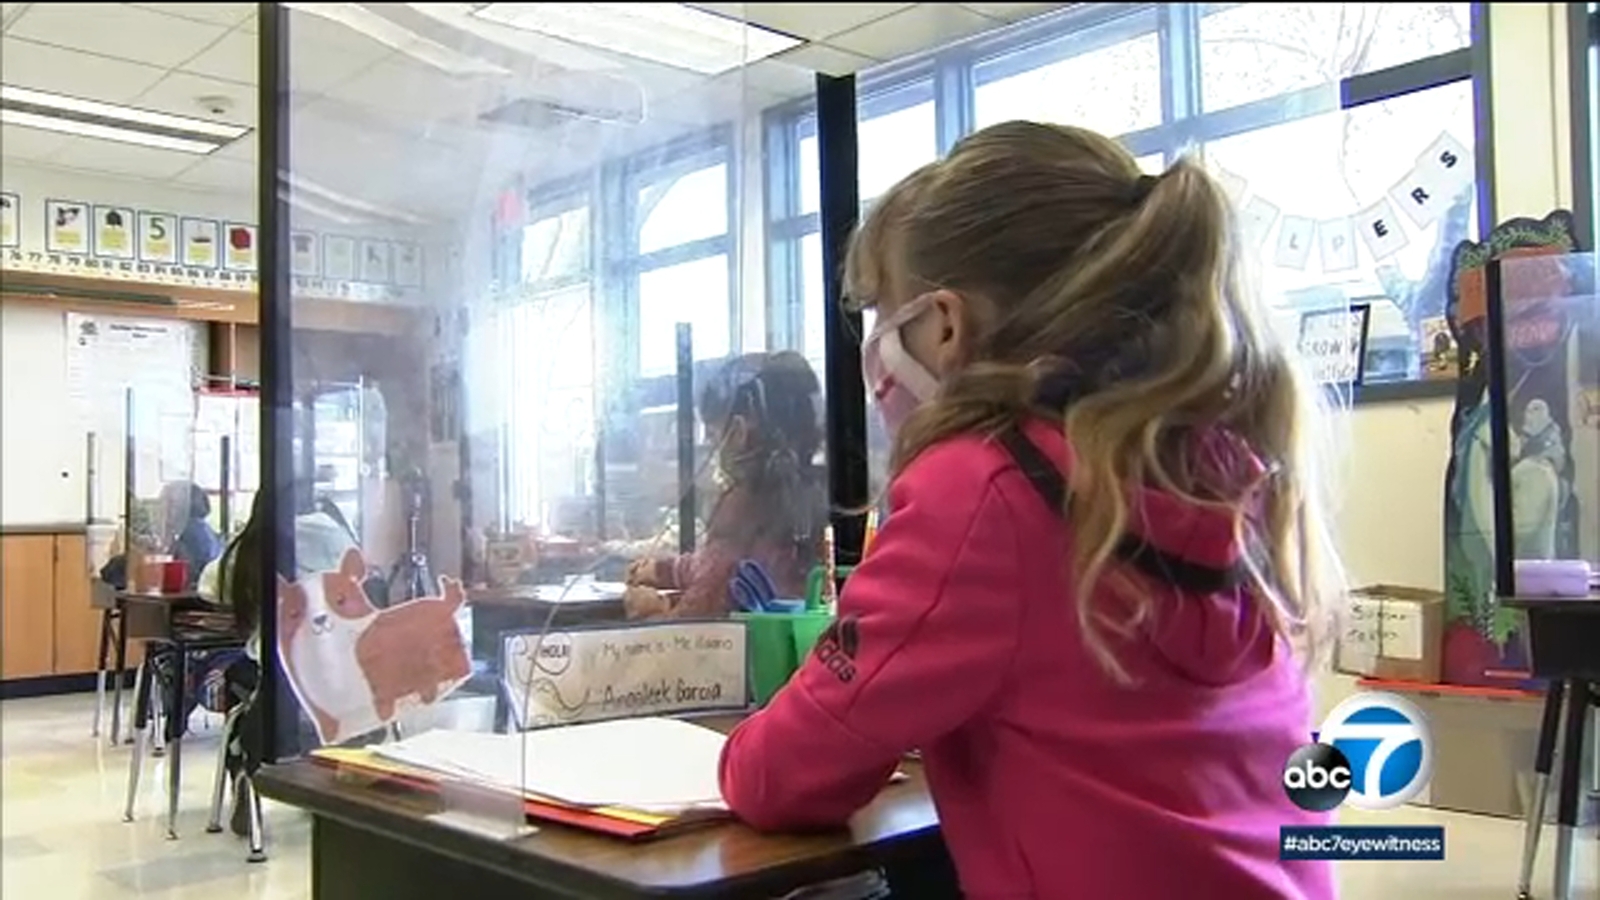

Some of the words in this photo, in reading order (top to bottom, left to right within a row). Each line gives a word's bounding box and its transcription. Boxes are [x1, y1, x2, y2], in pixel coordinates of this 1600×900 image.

[1288, 150, 1458, 251] LPERS
[150, 217, 165, 240] 5
[817, 643, 857, 683] das
